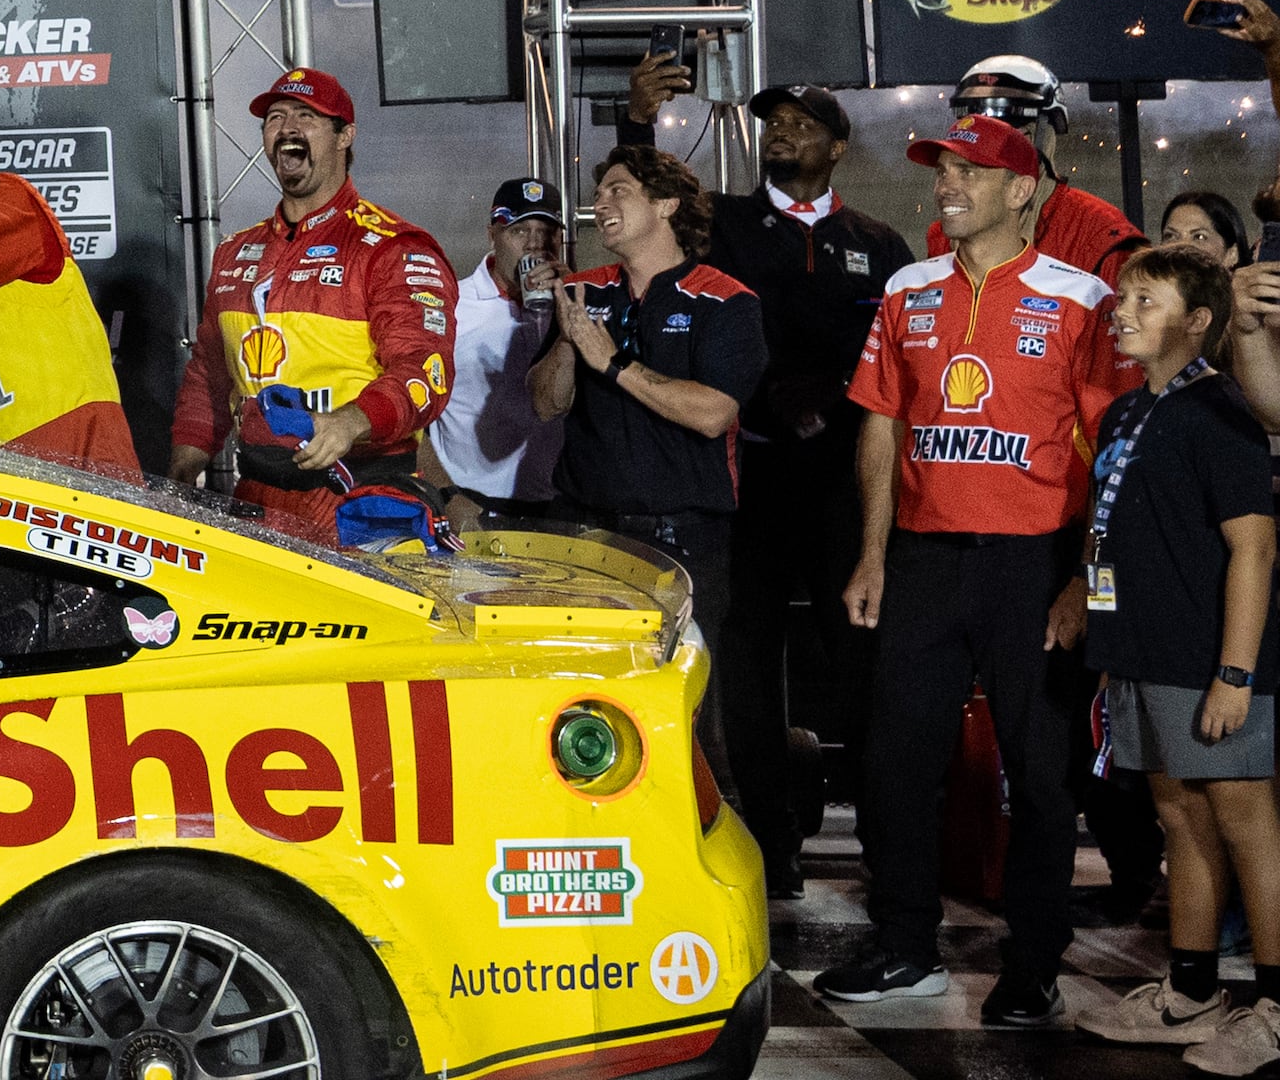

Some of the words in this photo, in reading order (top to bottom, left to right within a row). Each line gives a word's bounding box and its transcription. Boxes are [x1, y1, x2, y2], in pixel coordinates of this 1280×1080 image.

[16, 59, 97, 85] ATVs
[321, 267, 344, 285] PPG
[1018, 338, 1045, 354] PPG
[40, 532, 138, 572] TIRE
[192, 613, 369, 646] Snap-on
[527, 850, 598, 872] HUNT
[500, 872, 630, 894] BROTHERS
[527, 893, 603, 913] PIZZA
[449, 953, 640, 1000] Autotrader
